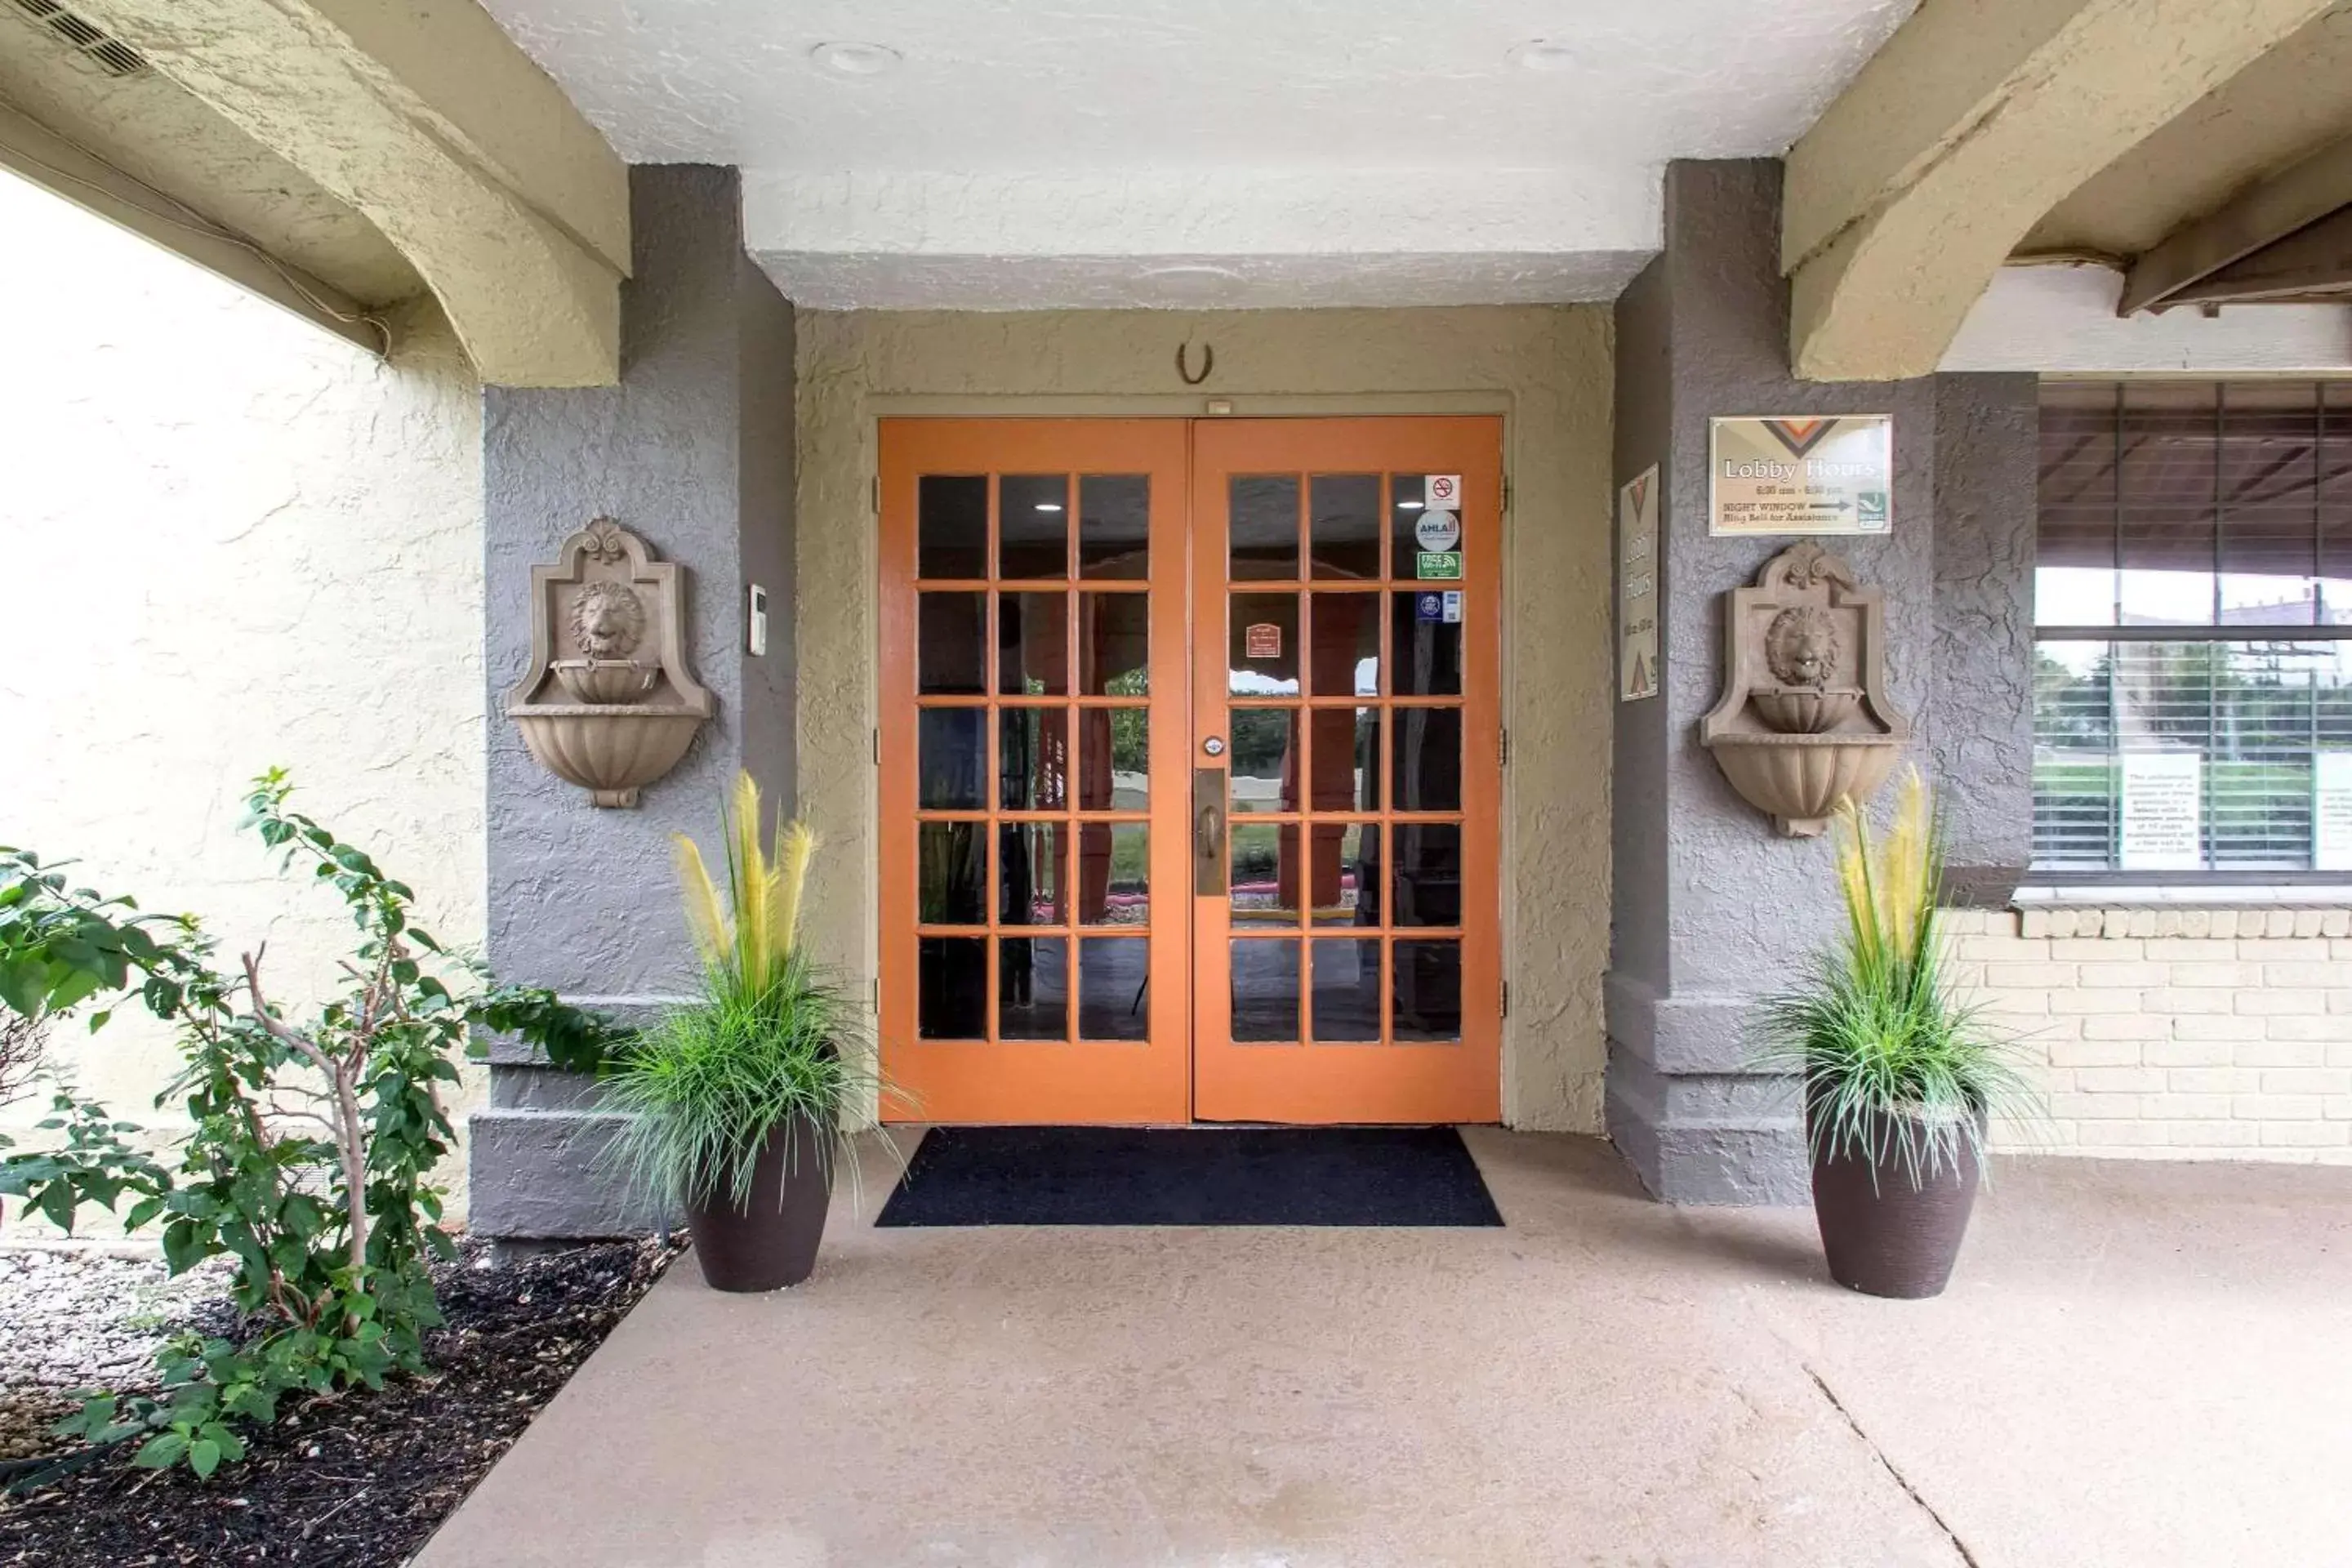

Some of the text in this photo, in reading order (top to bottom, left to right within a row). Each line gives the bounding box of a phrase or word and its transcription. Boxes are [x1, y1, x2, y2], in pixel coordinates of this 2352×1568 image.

[1724, 458, 1878, 483] Lobby Hours
[1722, 502, 1806, 512] NIGHT WINDOW
